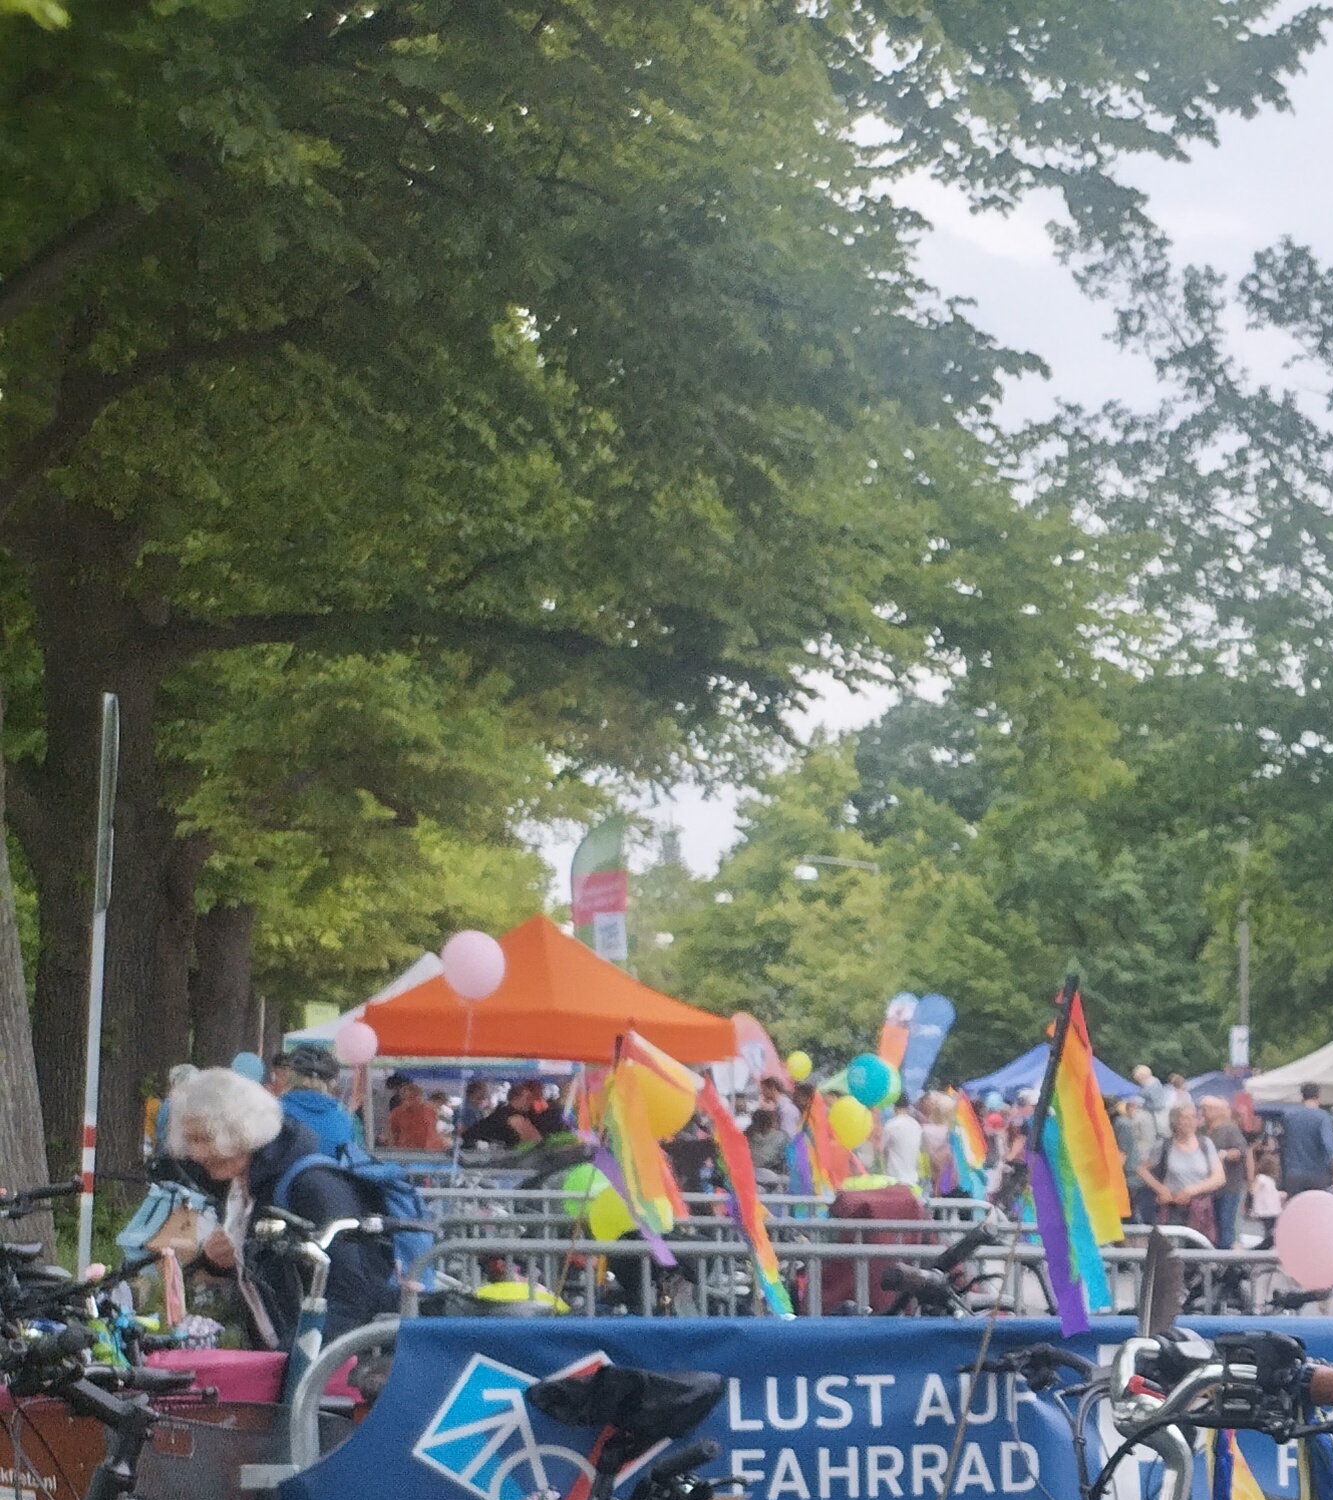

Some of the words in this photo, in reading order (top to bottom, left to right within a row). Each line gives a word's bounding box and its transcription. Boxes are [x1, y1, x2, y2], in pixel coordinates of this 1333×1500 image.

[728, 1373, 896, 1431] LUST
[914, 1372, 1038, 1425] AUF
[730, 1440, 1040, 1500] FAHRRAD
